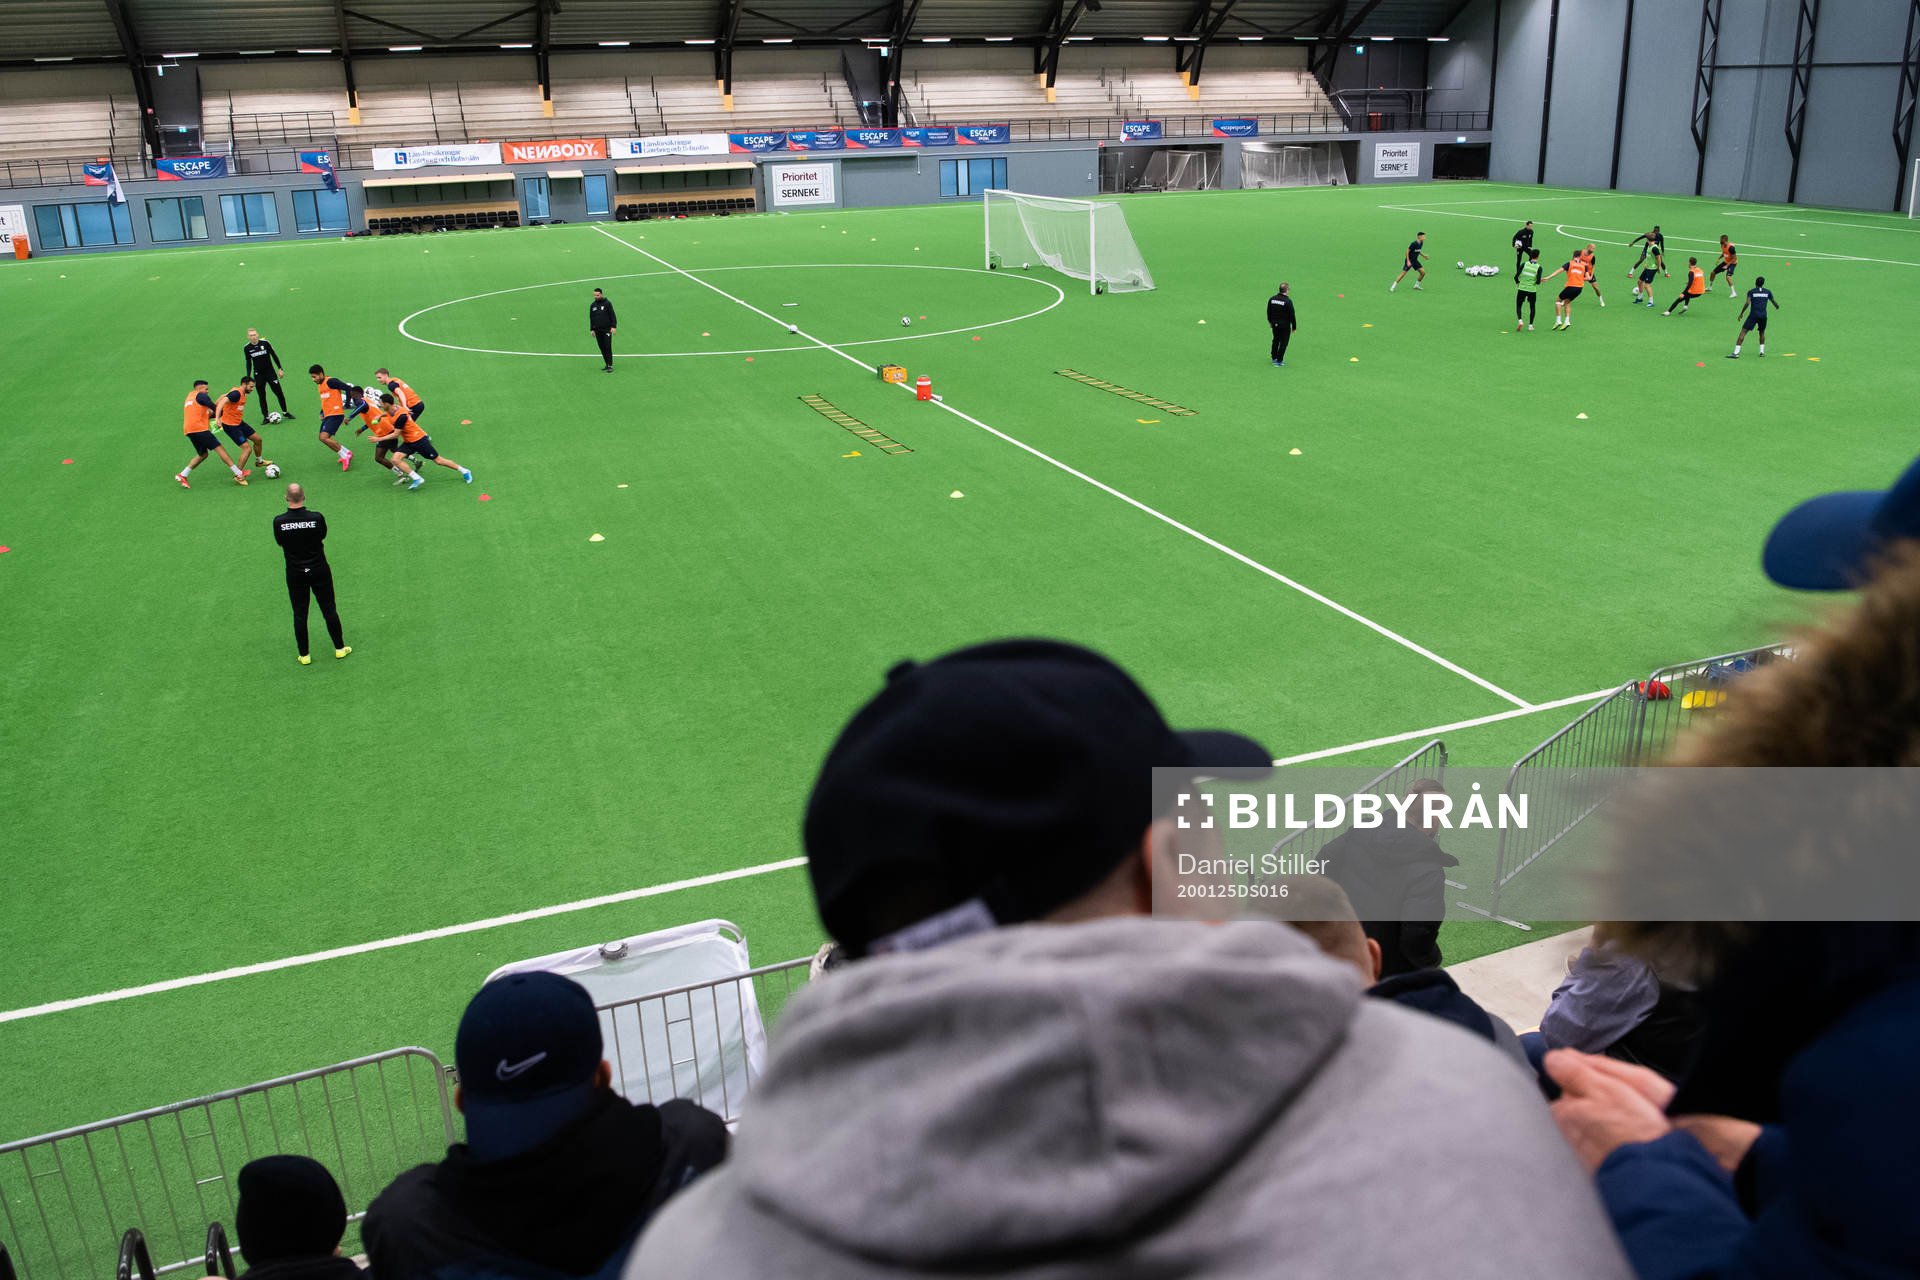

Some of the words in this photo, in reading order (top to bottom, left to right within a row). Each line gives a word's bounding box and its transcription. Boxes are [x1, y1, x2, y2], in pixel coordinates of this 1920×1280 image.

[970, 129, 997, 137] ESCAPE
[1125, 125, 1151, 133] ESCAPE
[743, 136, 774, 145] ESCAPE
[859, 132, 889, 141] ESCAPE
[1382, 149, 1408, 157] Prioritet
[173, 161, 211, 171] ESCAPE
[782, 172, 817, 181] Prioritet
[781, 188, 820, 198] SERNEKE
[280, 521, 317, 531] SERNEKE
